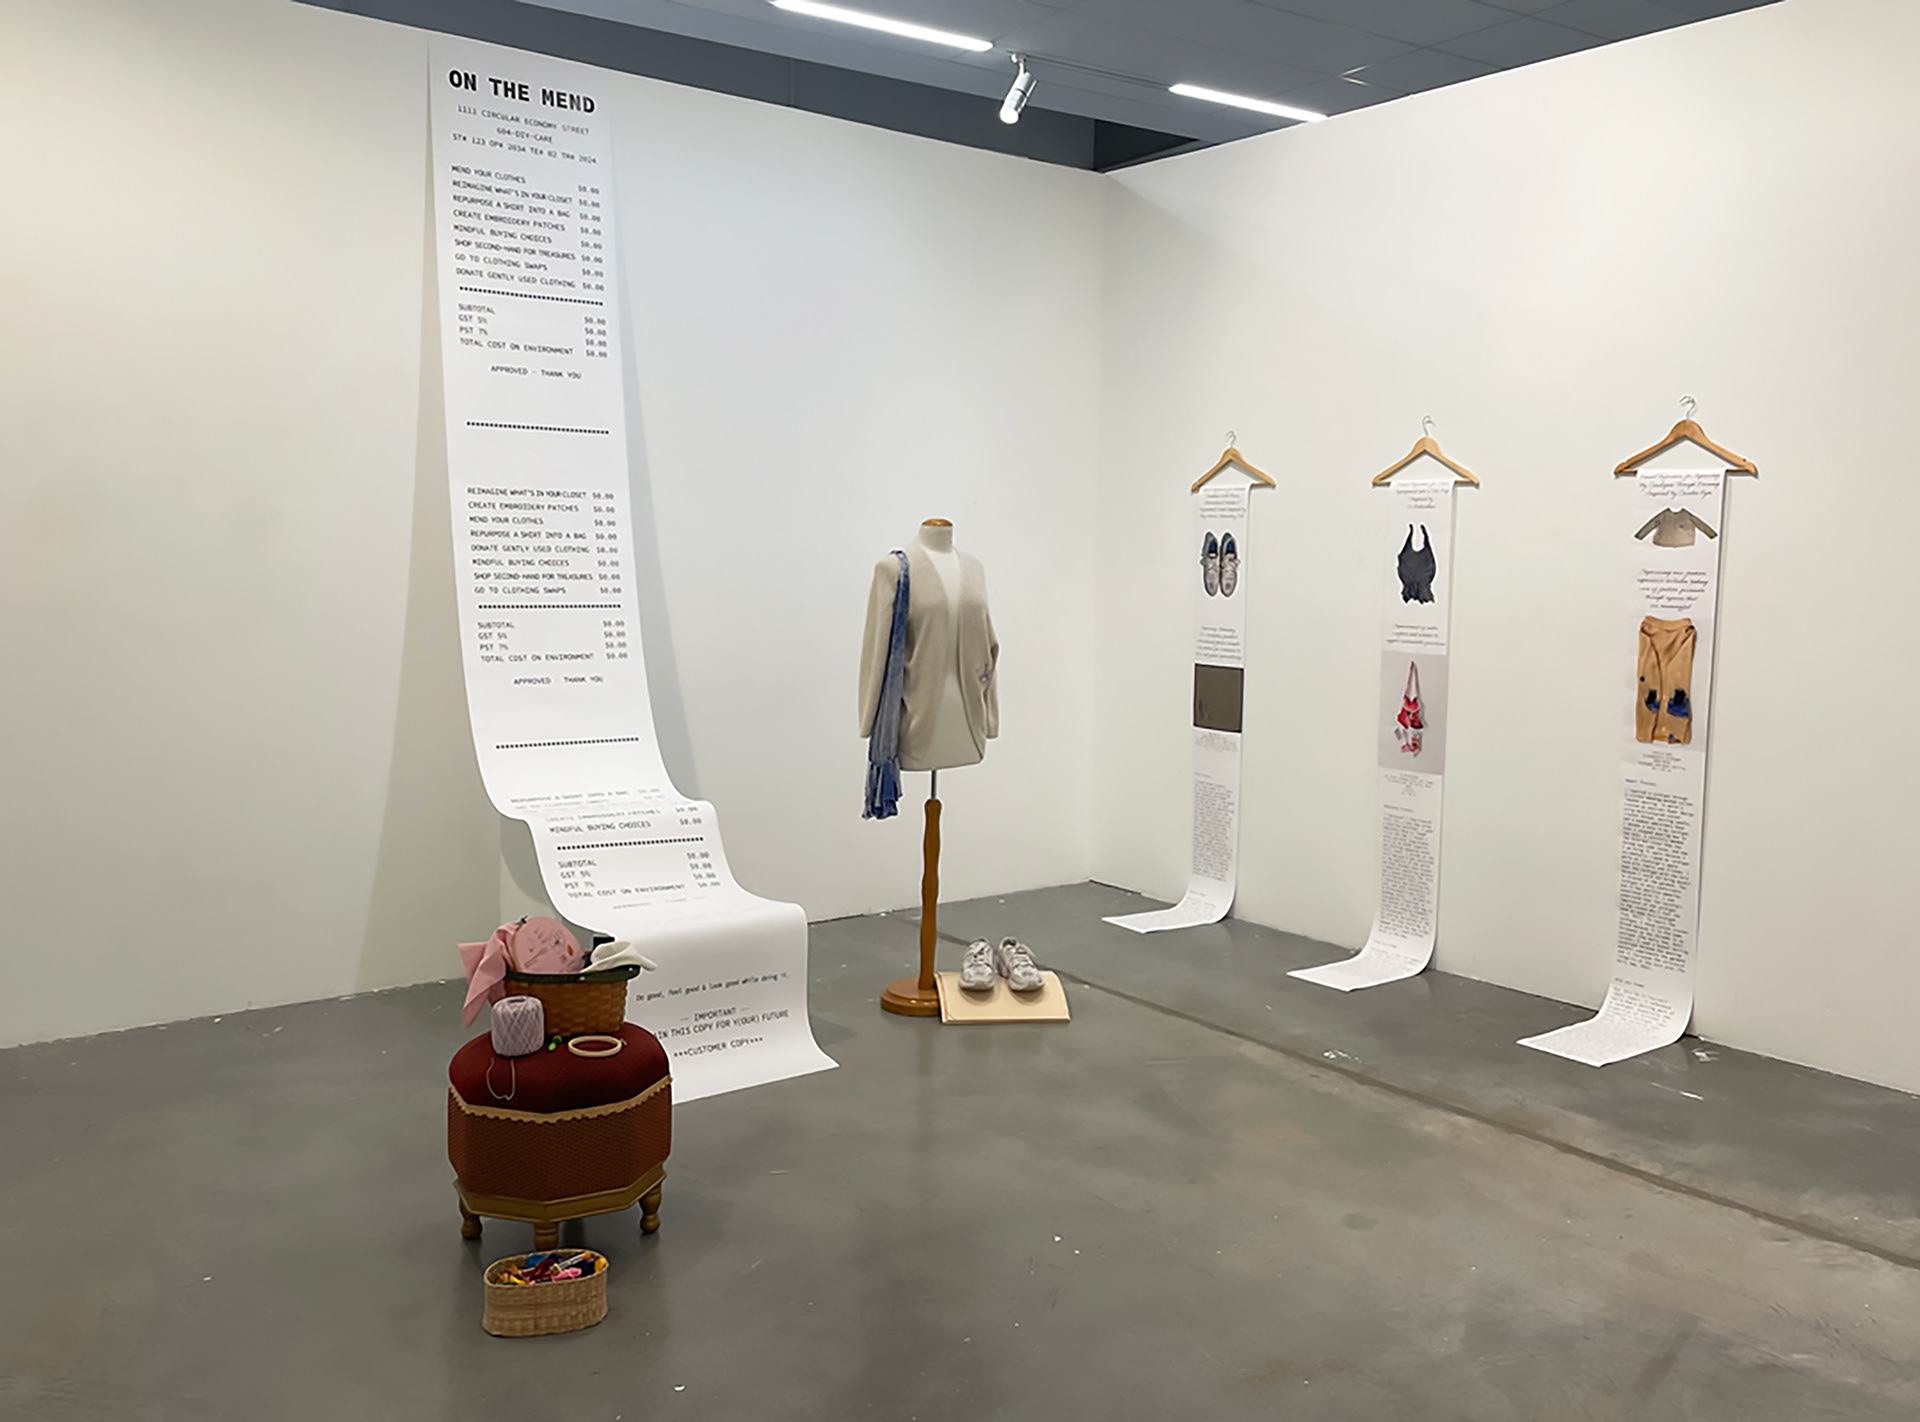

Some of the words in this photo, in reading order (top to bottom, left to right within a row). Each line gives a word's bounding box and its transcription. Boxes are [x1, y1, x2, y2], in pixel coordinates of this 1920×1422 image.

[449, 70, 477, 92] ON
[489, 78, 529, 102] THE
[542, 89, 595, 114] MEND
[458, 105, 477, 116] 1111
[481, 110, 521, 124] CIRCULAR
[524, 118, 558, 131] ECONOMY
[562, 124, 590, 136] STREET
[471, 137, 486, 146] 123
[451, 165, 472, 175] MEND
[474, 169, 492, 178] YOUR
[494, 172, 526, 184] CLOTHES
[452, 180, 493, 193] REIMAGINE
[494, 187, 520, 196] WHAT'S
[520, 191, 530, 199] IN
[531, 192, 547, 201] YOUR
[547, 194, 573, 205] CLOSET
[452, 195, 494, 208] REPURPOSE
[503, 202, 524, 212] SHIRT
[528, 206, 547, 216] INTO
[557, 210, 571, 219] BAG
[453, 209, 482, 221] CREATE
[484, 214, 531, 227] EMBROIDERY
[533, 220, 566, 232] PATCHES
[453, 224, 486, 235] MINDFUL
[489, 229, 518, 240] BUYING
[520, 233, 552, 244] CHOICES
[454, 239, 473, 248] SHOP
[474, 241, 522, 254] SECOND-HAND
[523, 248, 537, 256] FOR
[538, 250, 576, 261] TREASURES
[454, 253, 466, 262] GO
[469, 255, 480, 263] TO
[483, 257, 521, 269] CLOTHING
[524, 262, 548, 271] SWAPS
[455, 268, 484, 278] DONATE
[487, 271, 515, 282] GENTLY
[517, 275, 537, 285] USED
[539, 277, 576, 289] CLOTHING
[458, 303, 495, 315] SUBTOTAL
[458, 314, 473, 323] GST
[459, 326, 474, 335] PST
[460, 338, 483, 348] TOTAL
[487, 341, 506, 350] COST
[509, 343, 521, 351] ON
[523, 345, 573, 355] ENVIRONMENT
[491, 366, 529, 375] APPROVED
[541, 370, 564, 378] THANK
[567, 372, 582, 380] YOU
[467, 487, 508, 496] REIMAGINE
[561, 491, 587, 499] CLOSET
[468, 501, 497, 510] CREATE
[499, 503, 545, 511] EMBROIDERY
[547, 504, 579, 512] PATCHES
[469, 516, 489, 524] MEND
[512, 517, 544, 525] CLOTHES
[545, 532, 563, 540] INTO
[532, 545, 552, 553] USED
[554, 546, 590, 554] CLOTHING
[538, 559, 570, 567] CHOICES
[477, 632, 493, 640] GST
[481, 655, 504, 663] TOTAL
[545, 653, 594, 661] ENVIRONMENT
[513, 677, 552, 686] APPROVED
[694, 1007, 737, 1021] IMPORTANT
[671, 1026, 691, 1038] THIS
[693, 1022, 714, 1034] COPY
[716, 1019, 731, 1030] FOR
[761, 1009, 789, 1022] FUTURE
